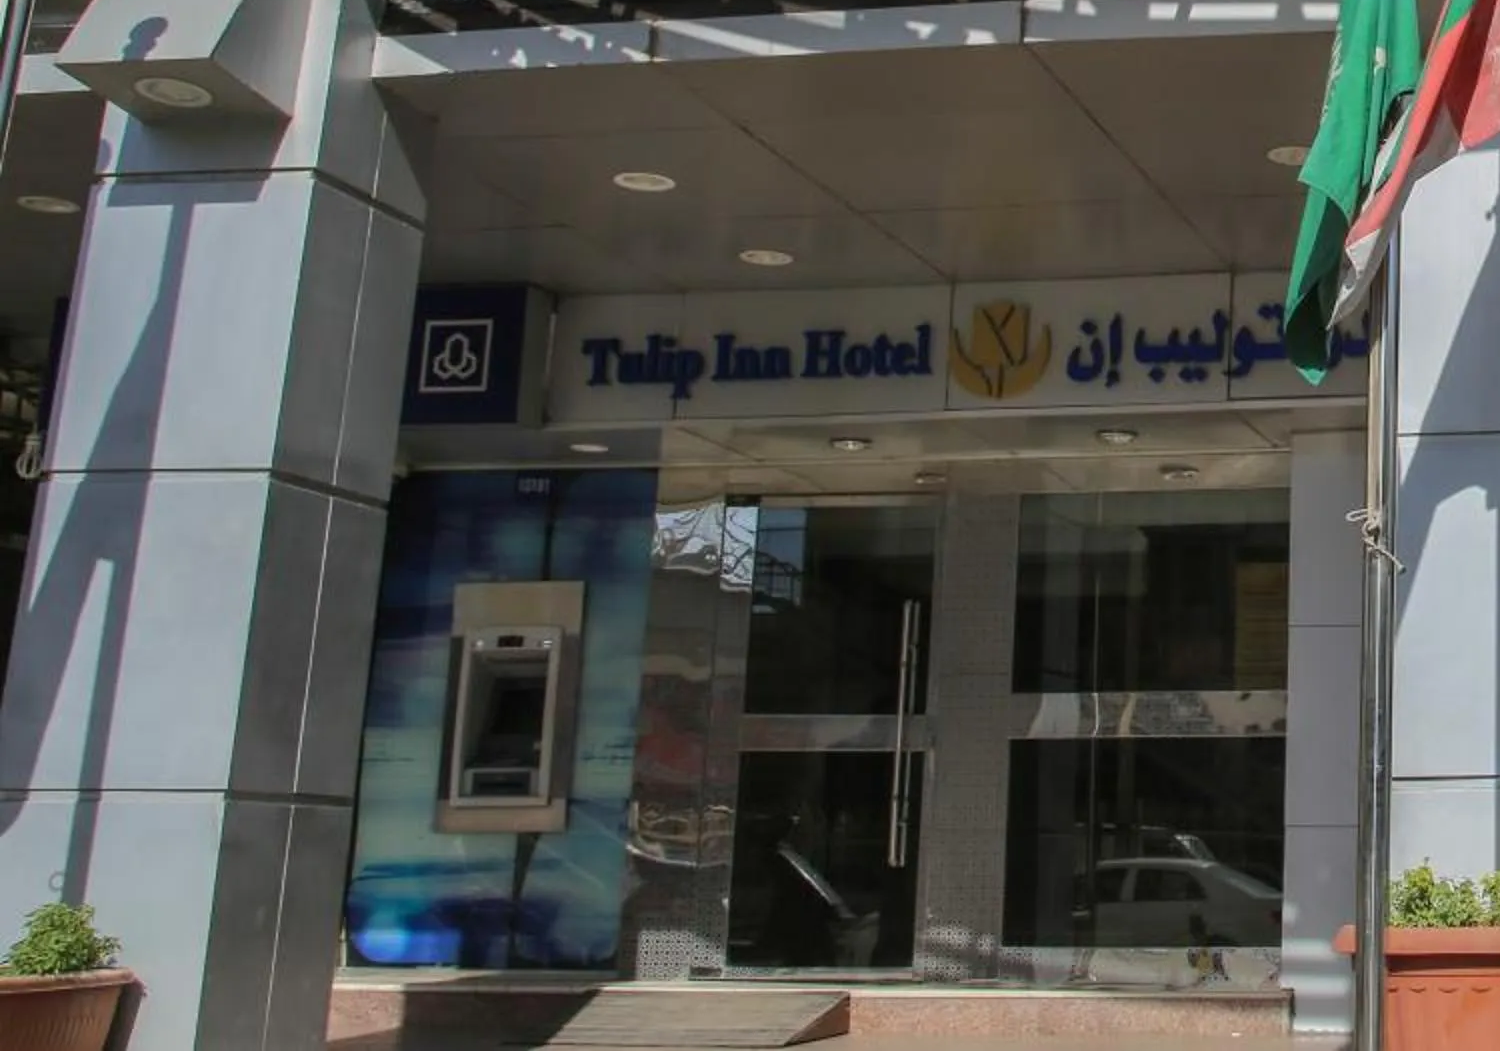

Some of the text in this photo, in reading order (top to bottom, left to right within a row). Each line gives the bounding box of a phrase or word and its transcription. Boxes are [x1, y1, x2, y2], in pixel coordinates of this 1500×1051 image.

[581, 322, 932, 400] Tulip Inn Hotel
[1066, 312, 1123, 388] إن
